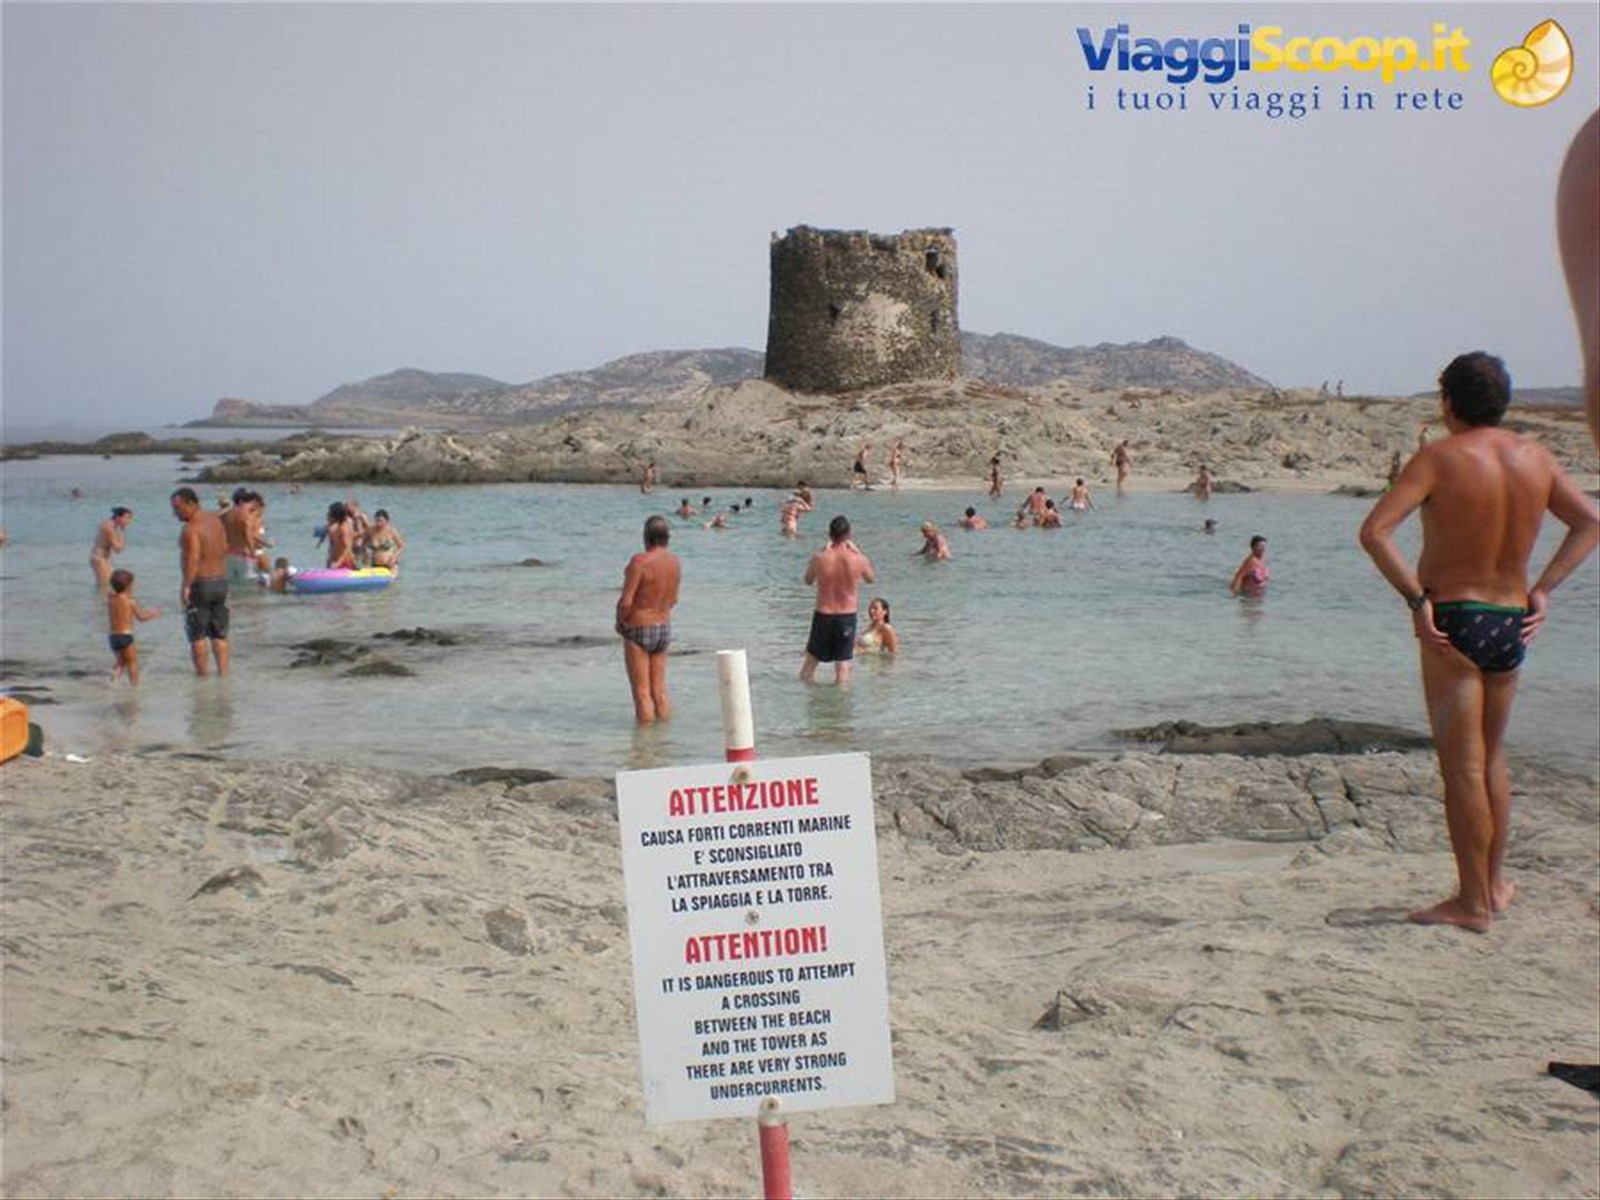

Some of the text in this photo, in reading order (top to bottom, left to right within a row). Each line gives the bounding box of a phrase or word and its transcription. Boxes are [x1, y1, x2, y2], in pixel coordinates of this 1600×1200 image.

[669, 778, 819, 816] ATTENZIONE
[641, 815, 851, 847] CAUSA FORTI CORRENTI MARINE
[694, 842, 802, 864] E' SCONSIGLIATO
[667, 863, 833, 890] L'ATTRAVERSAMENTO TRA
[672, 885, 832, 913] LA SPIAGGIA E LA TORRE.
[685, 926, 827, 964] ATTENTION!
[663, 963, 855, 993] IT IS DANGEROUS TO ATTEMPT
[721, 990, 800, 1010] A CROSSING
[695, 1009, 831, 1035] BETWEEN THE BEACH
[702, 1032, 827, 1056] AND THE TOWER AS
[686, 1052, 847, 1080] THERE ARE VERY STRONG
[710, 1076, 826, 1100] UNDERCURRENTS.
